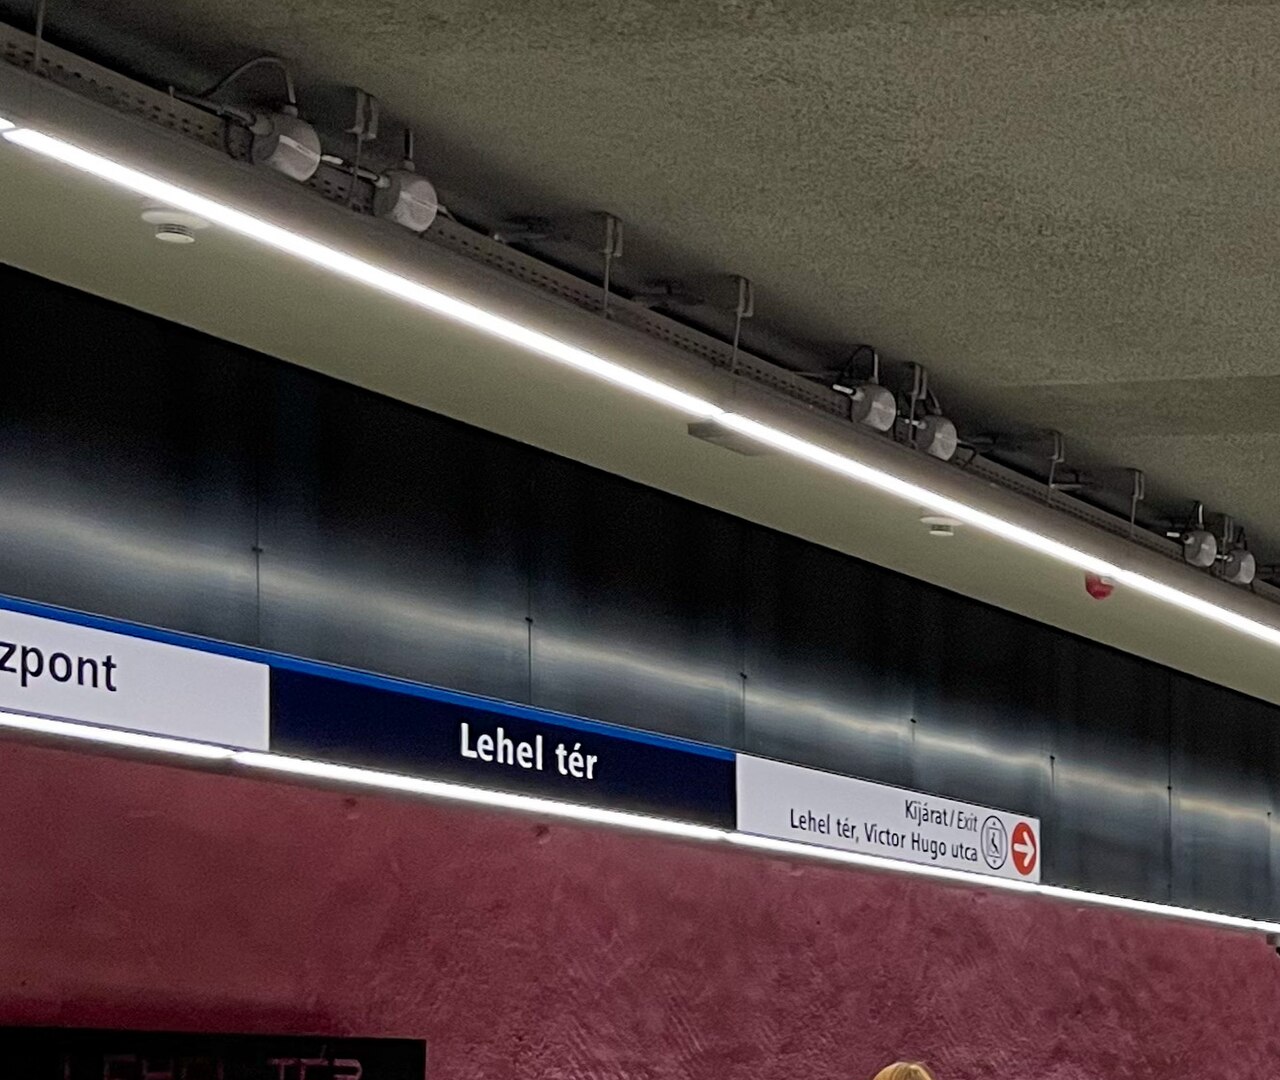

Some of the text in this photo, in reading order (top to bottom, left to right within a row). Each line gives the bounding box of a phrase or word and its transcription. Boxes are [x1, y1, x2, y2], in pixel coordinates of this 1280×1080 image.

[0, 641, 117, 692] zpont
[460, 722, 598, 780] Lehel tér
[790, 808, 978, 862] Lehel tér, Victor Hugo utca
[904, 799, 949, 827] Kijárat
[957, 810, 978, 832] Exit
